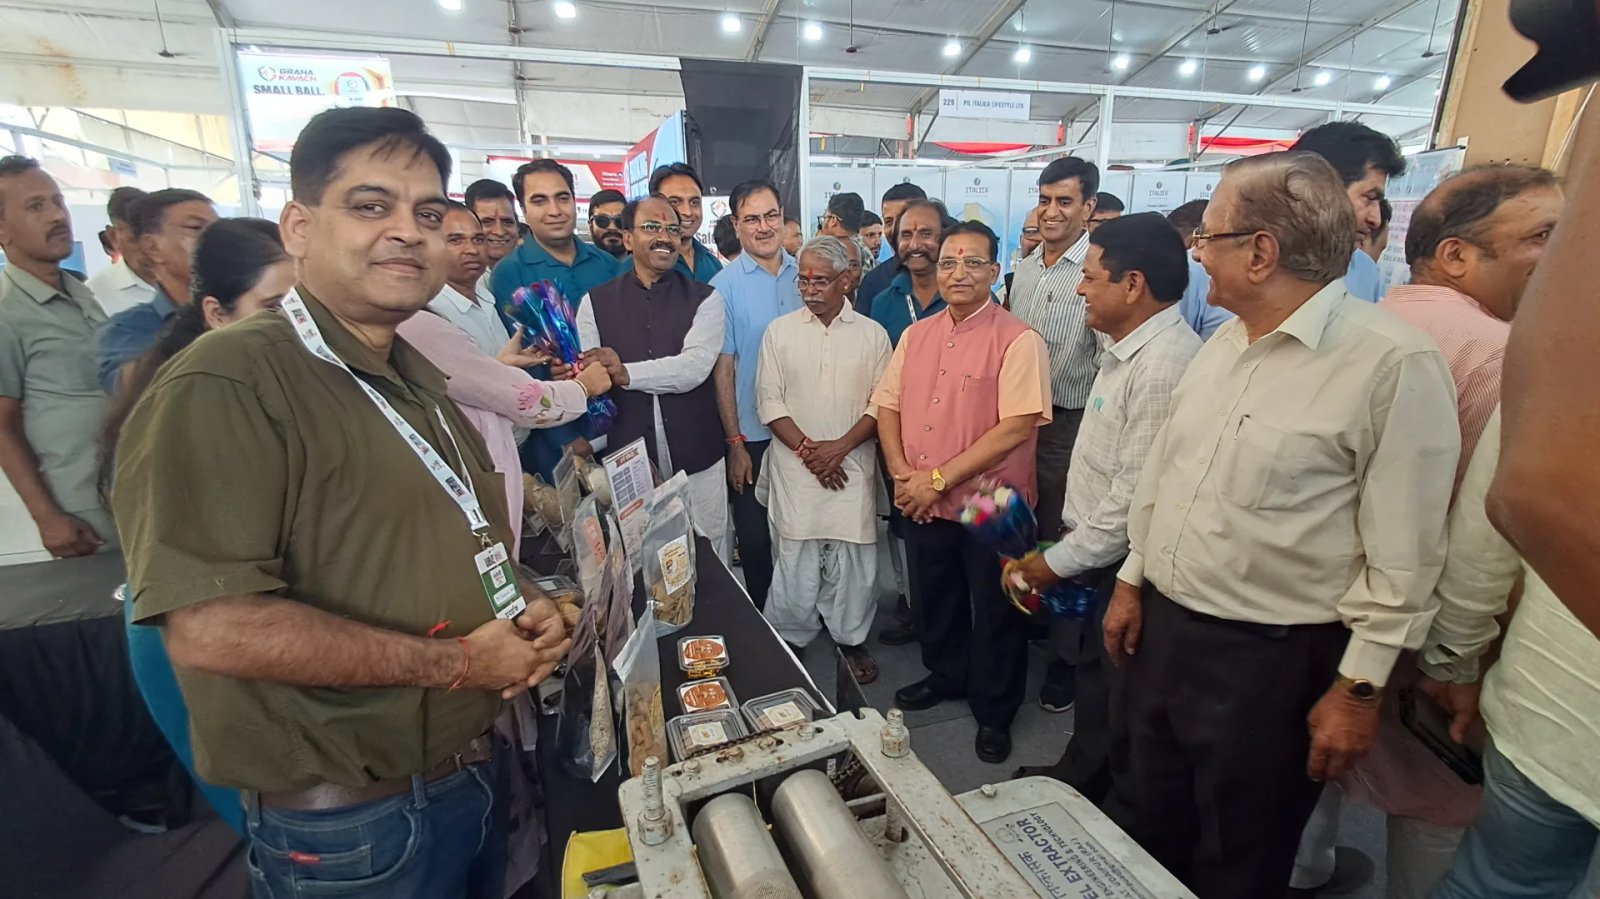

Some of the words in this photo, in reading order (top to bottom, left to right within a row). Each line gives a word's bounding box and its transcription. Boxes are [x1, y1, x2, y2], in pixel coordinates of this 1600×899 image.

[253, 84, 294, 95] SMALL
[1028, 812, 1069, 848] TECHNOLOGY
[1016, 818, 1083, 883] EXTRACTOR
[1070, 854, 1115, 897] ENGINEERING
[1079, 883, 1100, 899] EL
